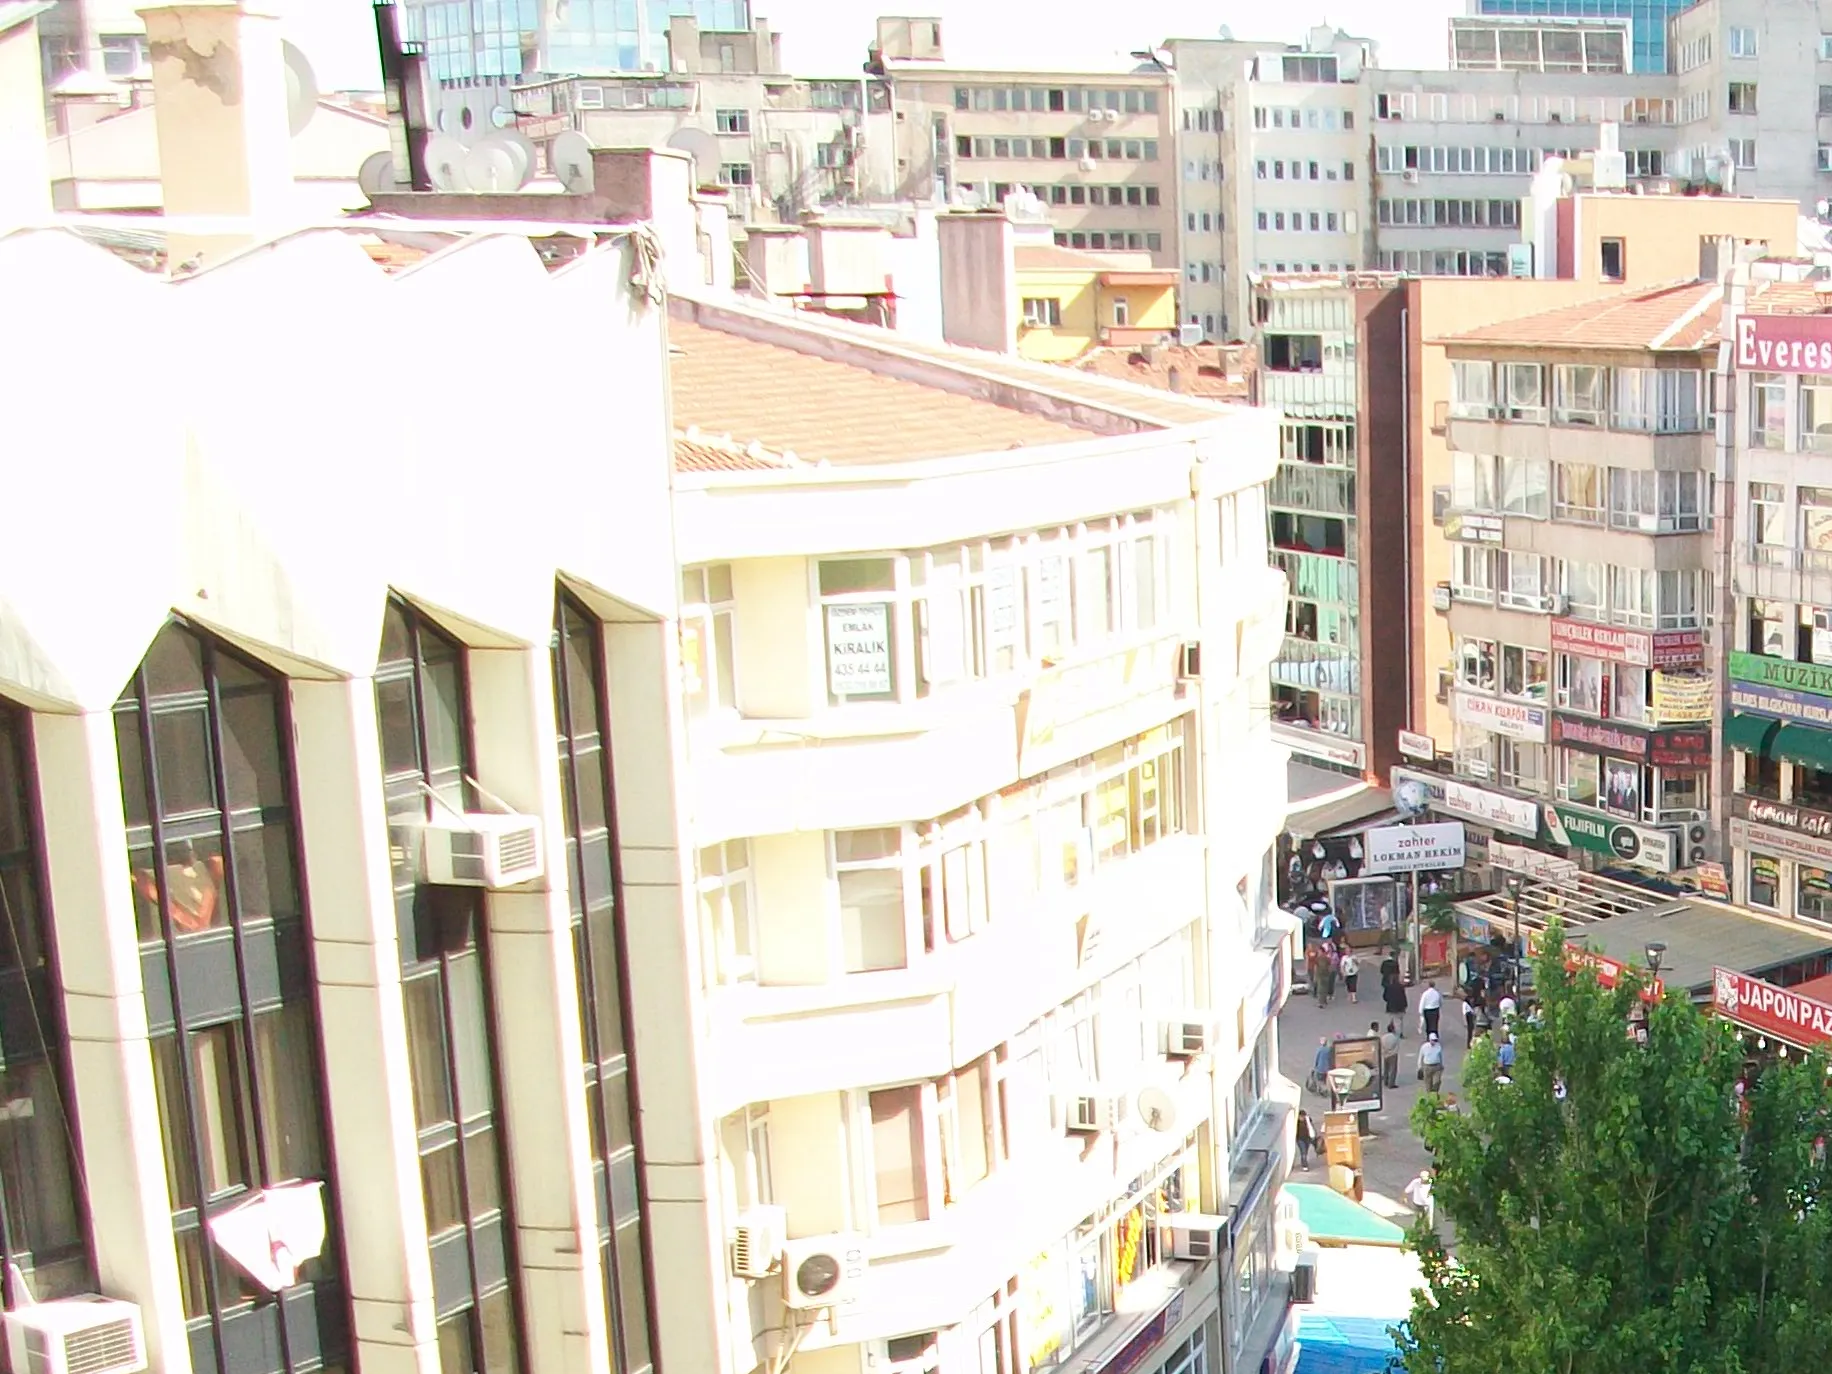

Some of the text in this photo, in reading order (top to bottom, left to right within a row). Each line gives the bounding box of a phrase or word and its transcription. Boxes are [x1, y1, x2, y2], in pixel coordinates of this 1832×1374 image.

[1564, 815, 1606, 839] FUJIFILM
[1397, 836, 1437, 849] zahter
[1373, 850, 1421, 862] LOKMAN
[1739, 984, 1798, 1026] JAPON
